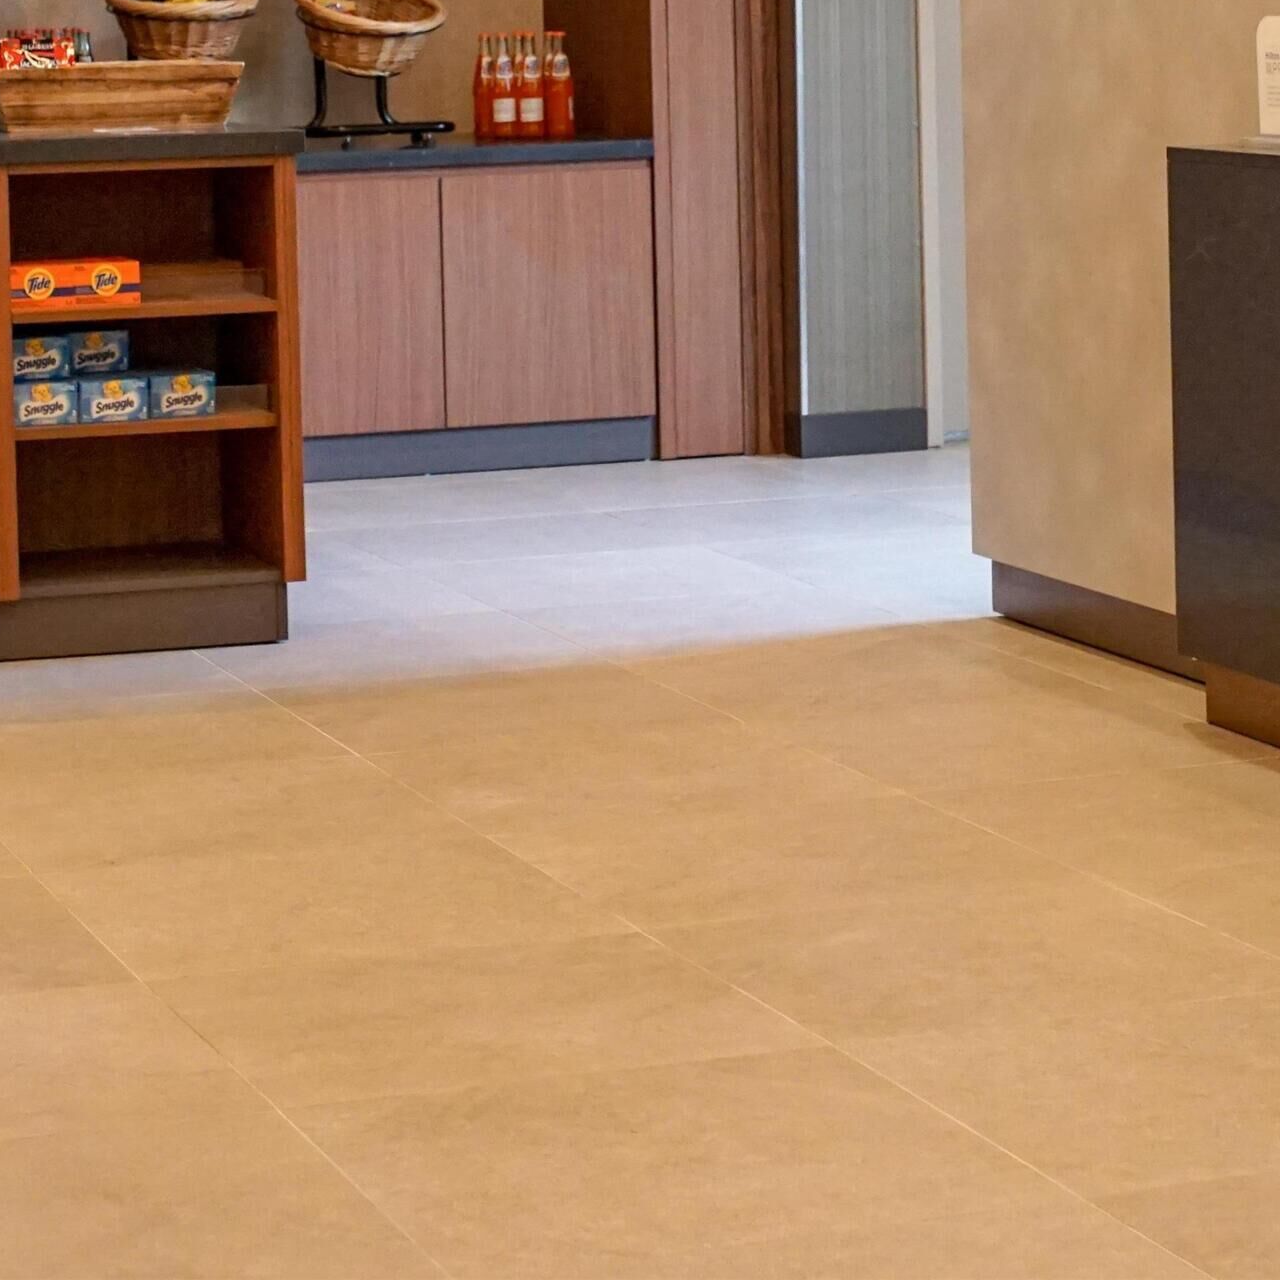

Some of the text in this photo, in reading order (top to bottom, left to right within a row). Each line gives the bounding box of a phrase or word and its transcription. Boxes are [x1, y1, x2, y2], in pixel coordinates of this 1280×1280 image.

[28, 277, 51, 294] Tide
[95, 273, 118, 290] Tide
[16, 355, 57, 372] Snuggle
[77, 349, 117, 365] Snuggle
[95, 397, 135, 414] Snuggle
[165, 391, 203, 408] Snuggle
[24, 400, 65, 418] Snuggle
